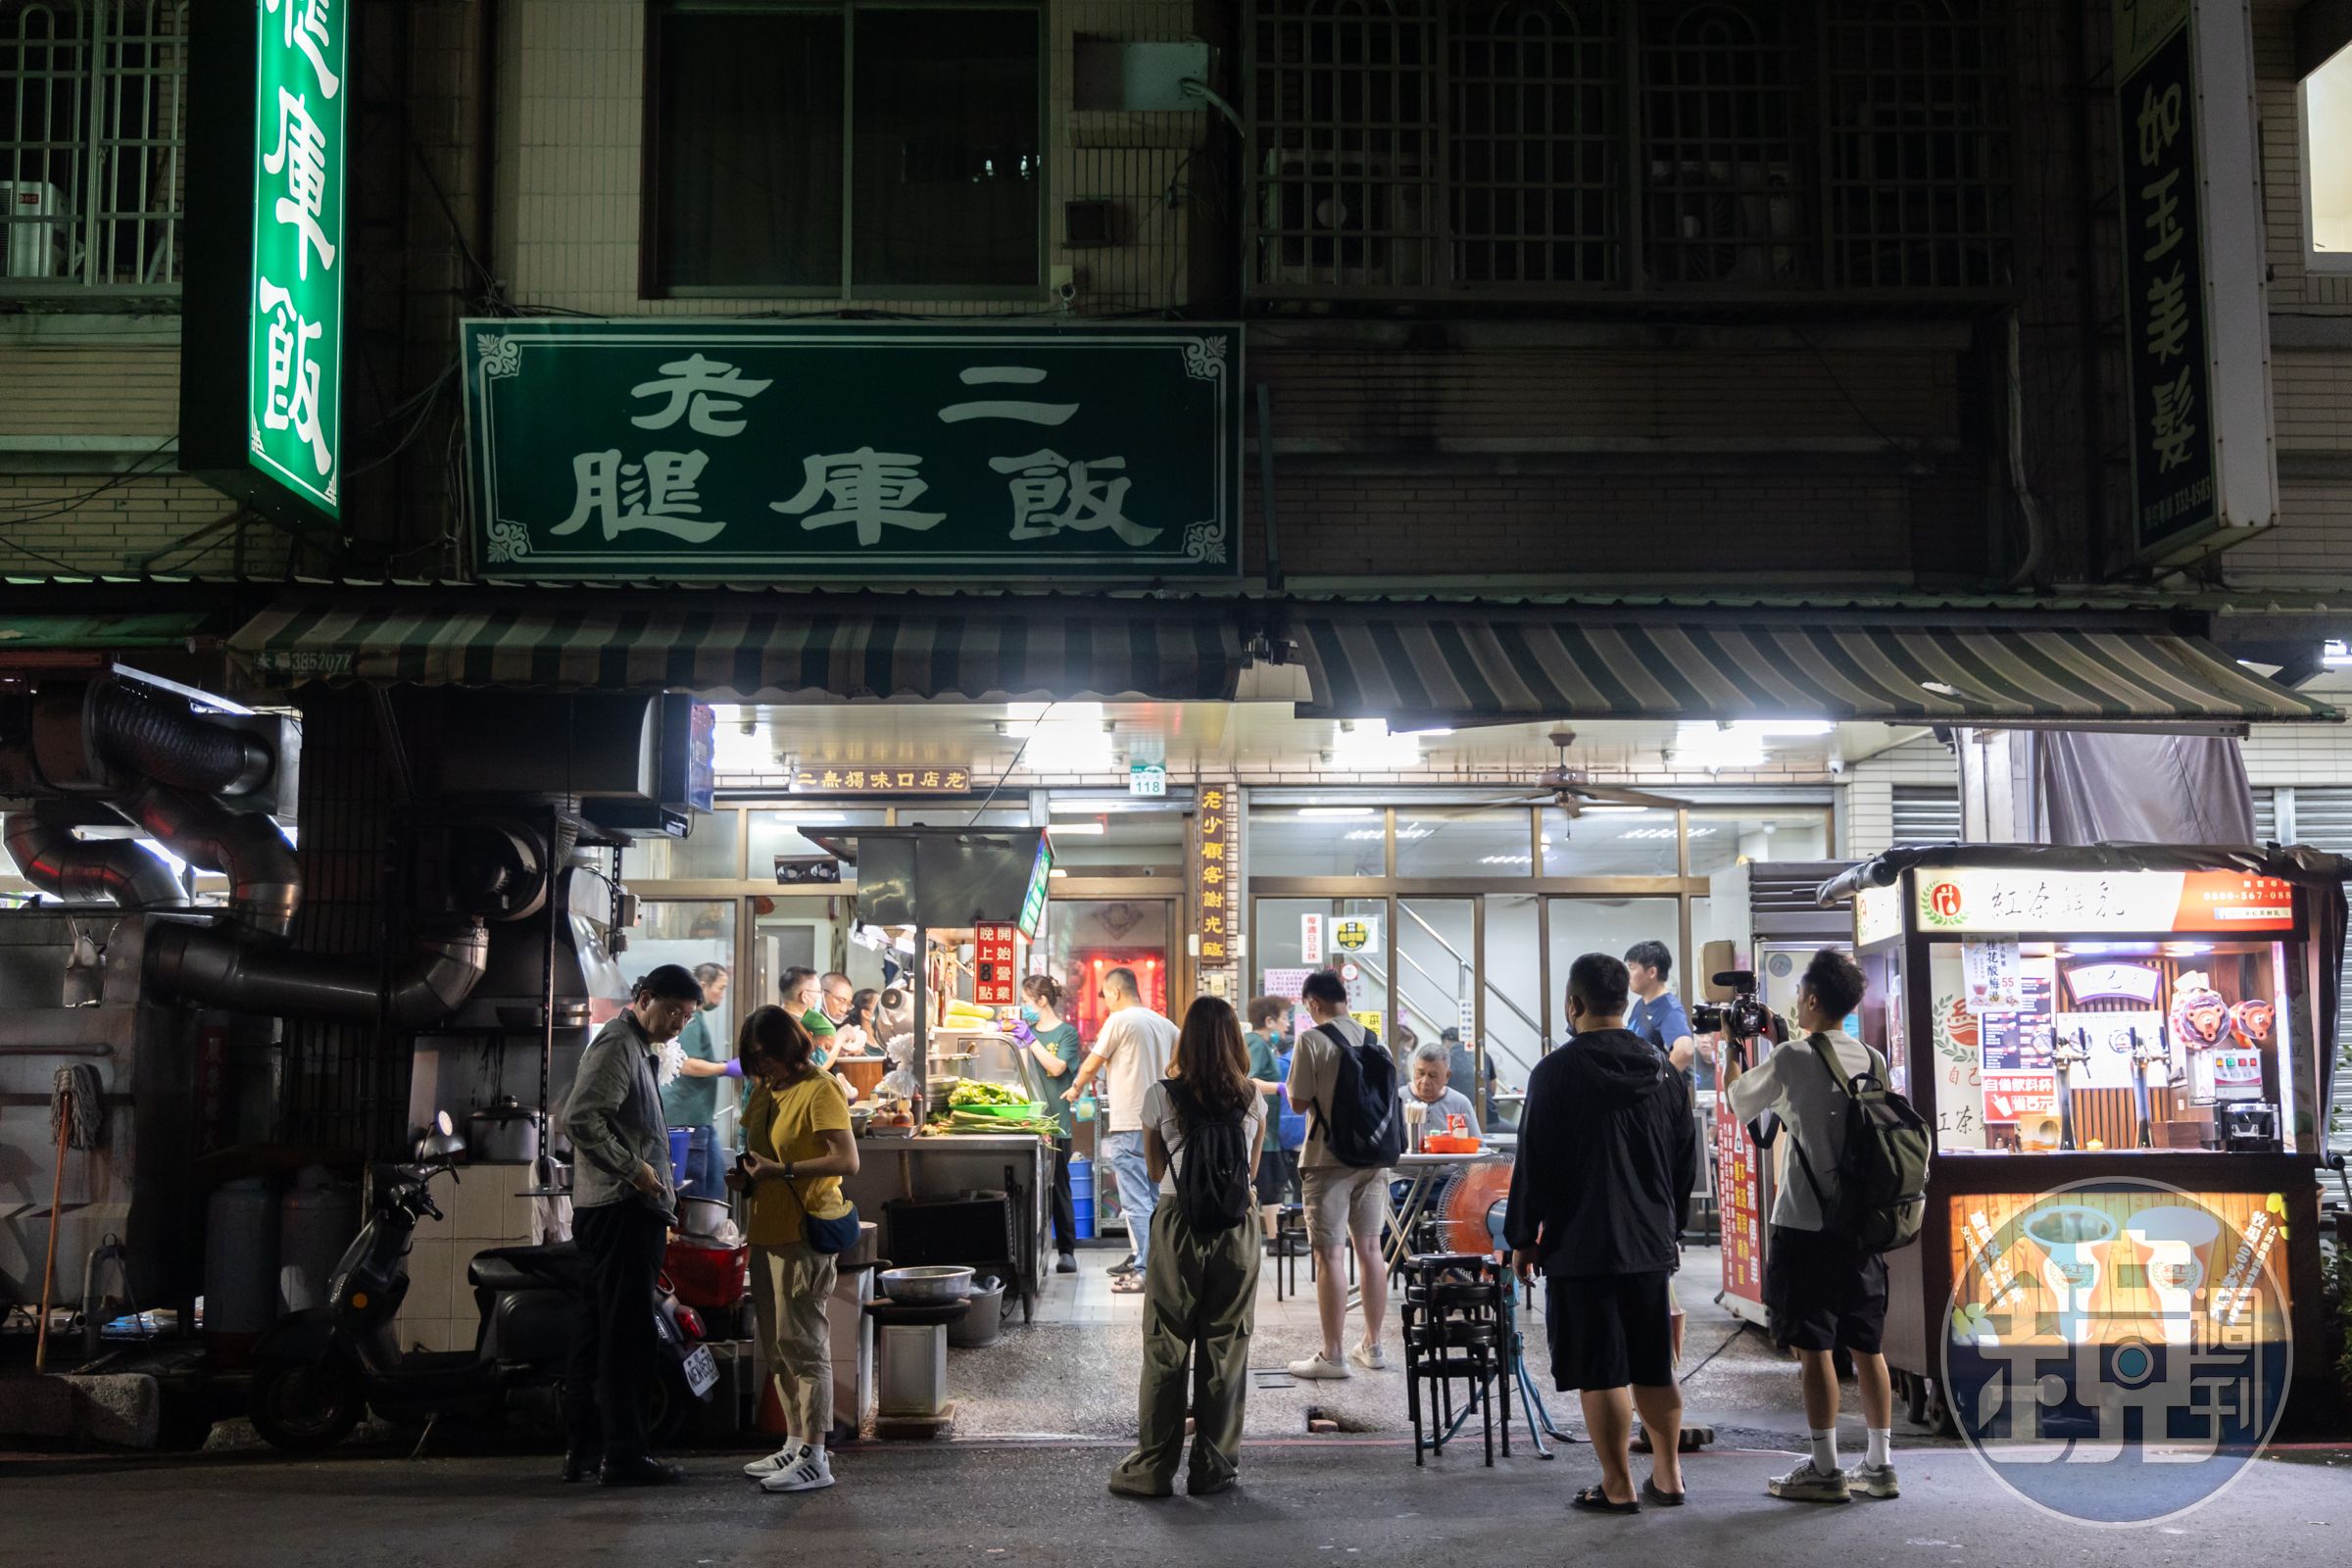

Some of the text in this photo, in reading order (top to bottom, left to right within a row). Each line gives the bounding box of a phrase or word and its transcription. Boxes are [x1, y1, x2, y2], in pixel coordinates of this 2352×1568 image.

[2137, 81, 2195, 473] 如玉美髮
[549, 446, 1164, 546] 腿庫飯
[1136, 781, 1160, 792] 118
[1984, 1078, 2053, 1092] 自備飲料杯
